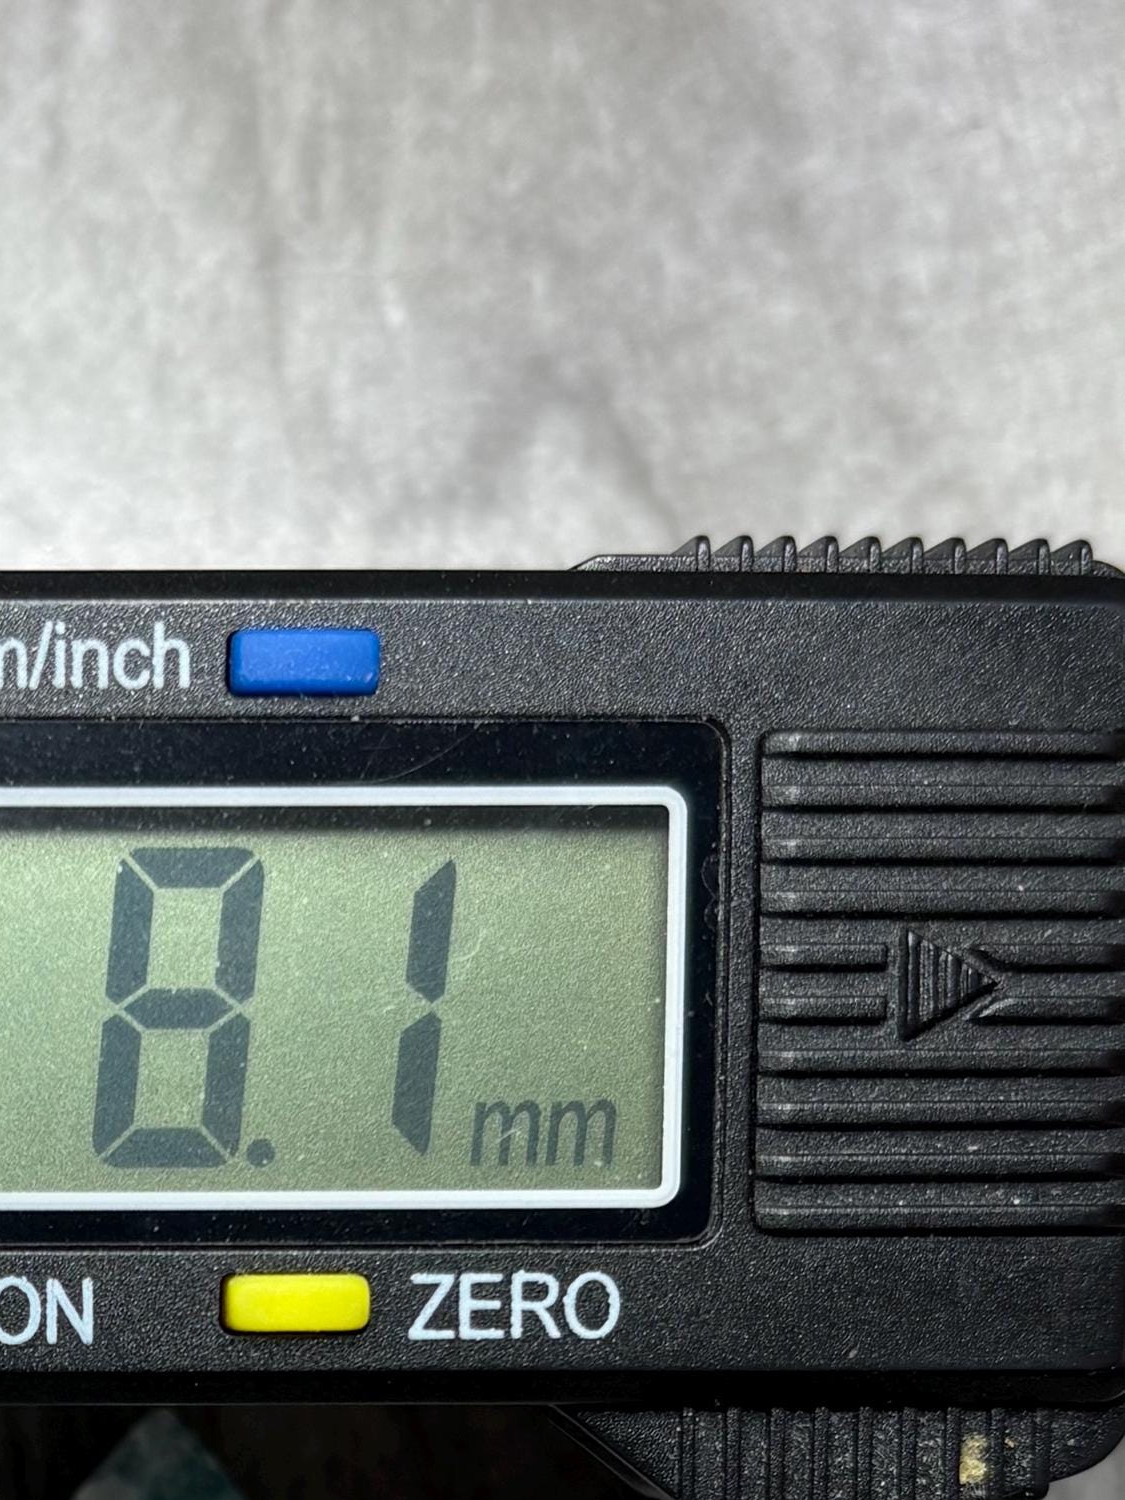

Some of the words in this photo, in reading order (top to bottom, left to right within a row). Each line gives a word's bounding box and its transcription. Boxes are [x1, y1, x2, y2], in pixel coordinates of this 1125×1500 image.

[92, 846, 457, 1169] 8.1
[470, 1099, 617, 1168] mm
[407, 1270, 622, 1341] ZERO
